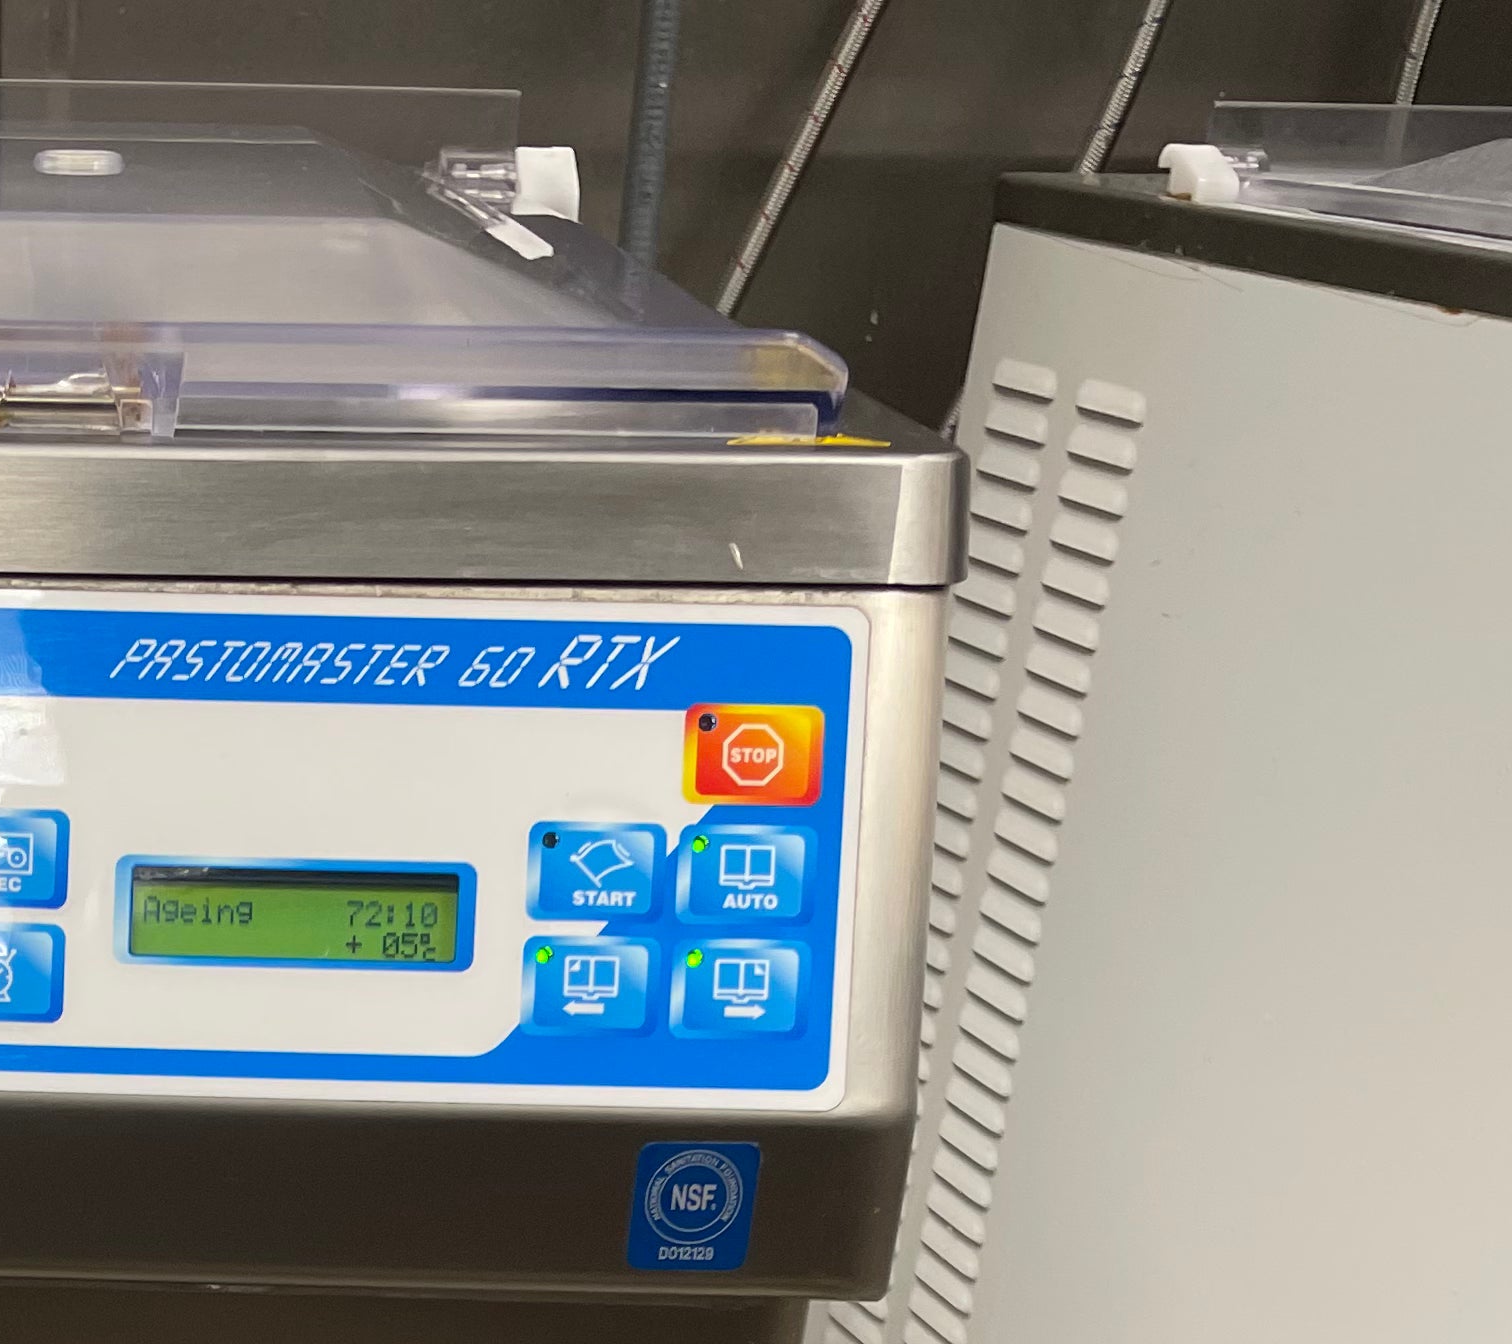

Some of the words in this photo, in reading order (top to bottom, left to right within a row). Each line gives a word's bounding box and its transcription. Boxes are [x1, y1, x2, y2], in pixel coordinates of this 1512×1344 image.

[110, 637, 450, 689] PASTOMASTER
[458, 645, 535, 689] 60
[538, 635, 680, 692] RTX
[730, 745, 777, 765] STOP
[572, 889, 636, 908] START
[722, 893, 779, 911] AUTO
[143, 895, 254, 925] Ageing
[346, 900, 439, 928] 72:10
